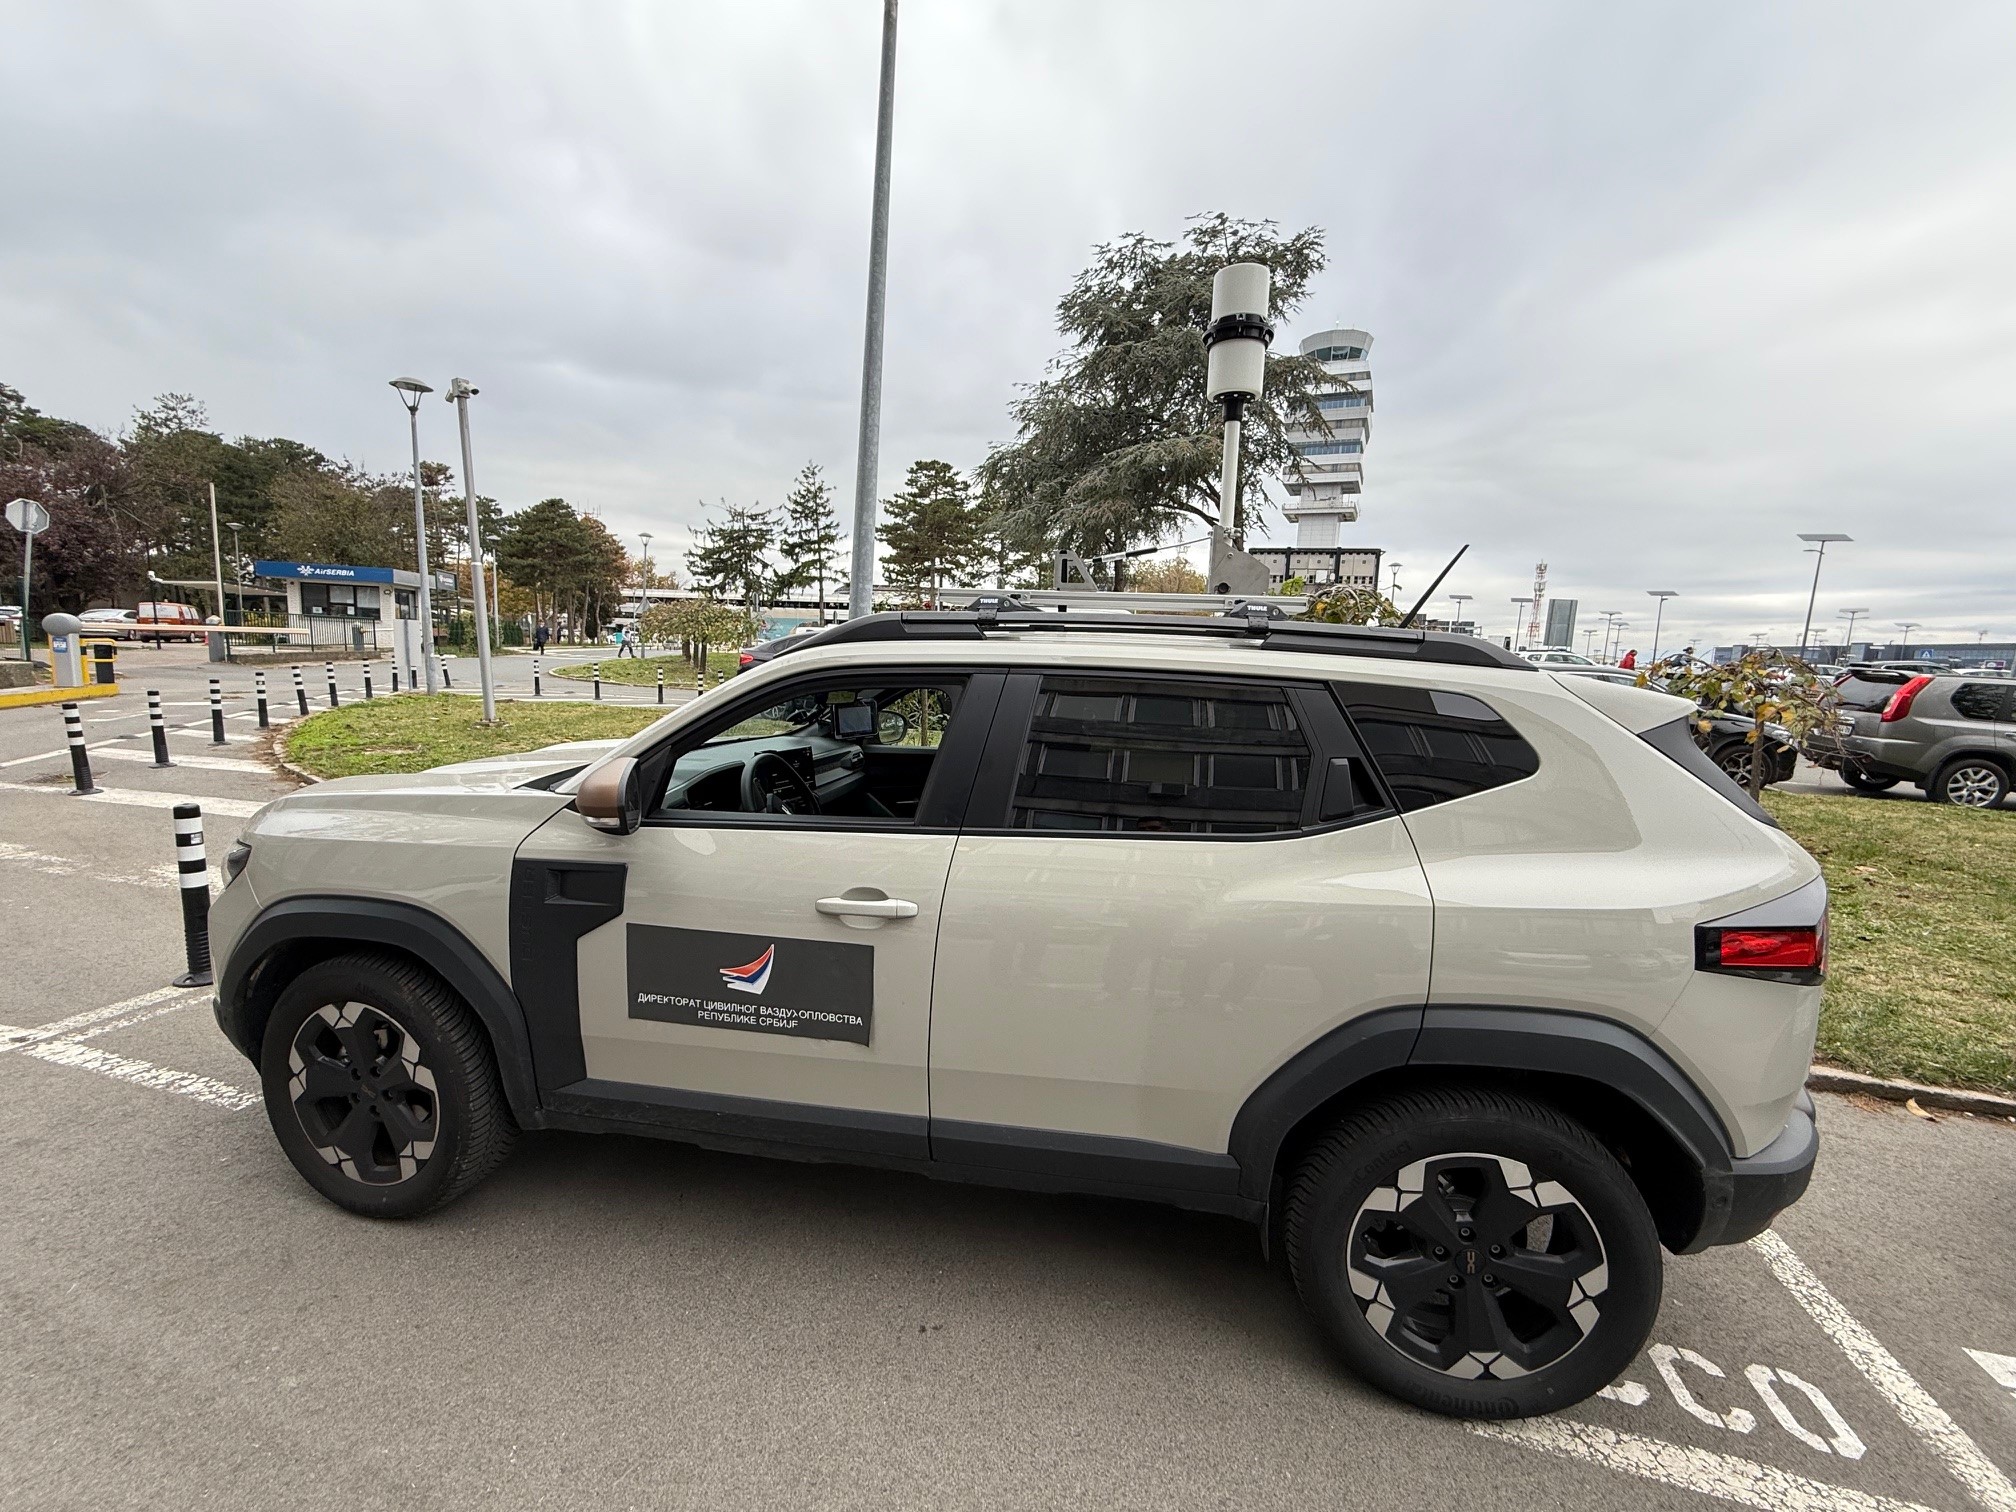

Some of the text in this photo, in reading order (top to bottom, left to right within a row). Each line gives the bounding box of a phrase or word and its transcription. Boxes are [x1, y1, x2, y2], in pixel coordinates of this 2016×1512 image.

[314, 568, 355, 577] AirSERBIA
[637, 992, 701, 1009] ДИРЕКТОРАТ
[703, 1000, 758, 1014] ЦИВИЛНОГ
[697, 1010, 757, 1025] РЕПУБЛИКЕ
